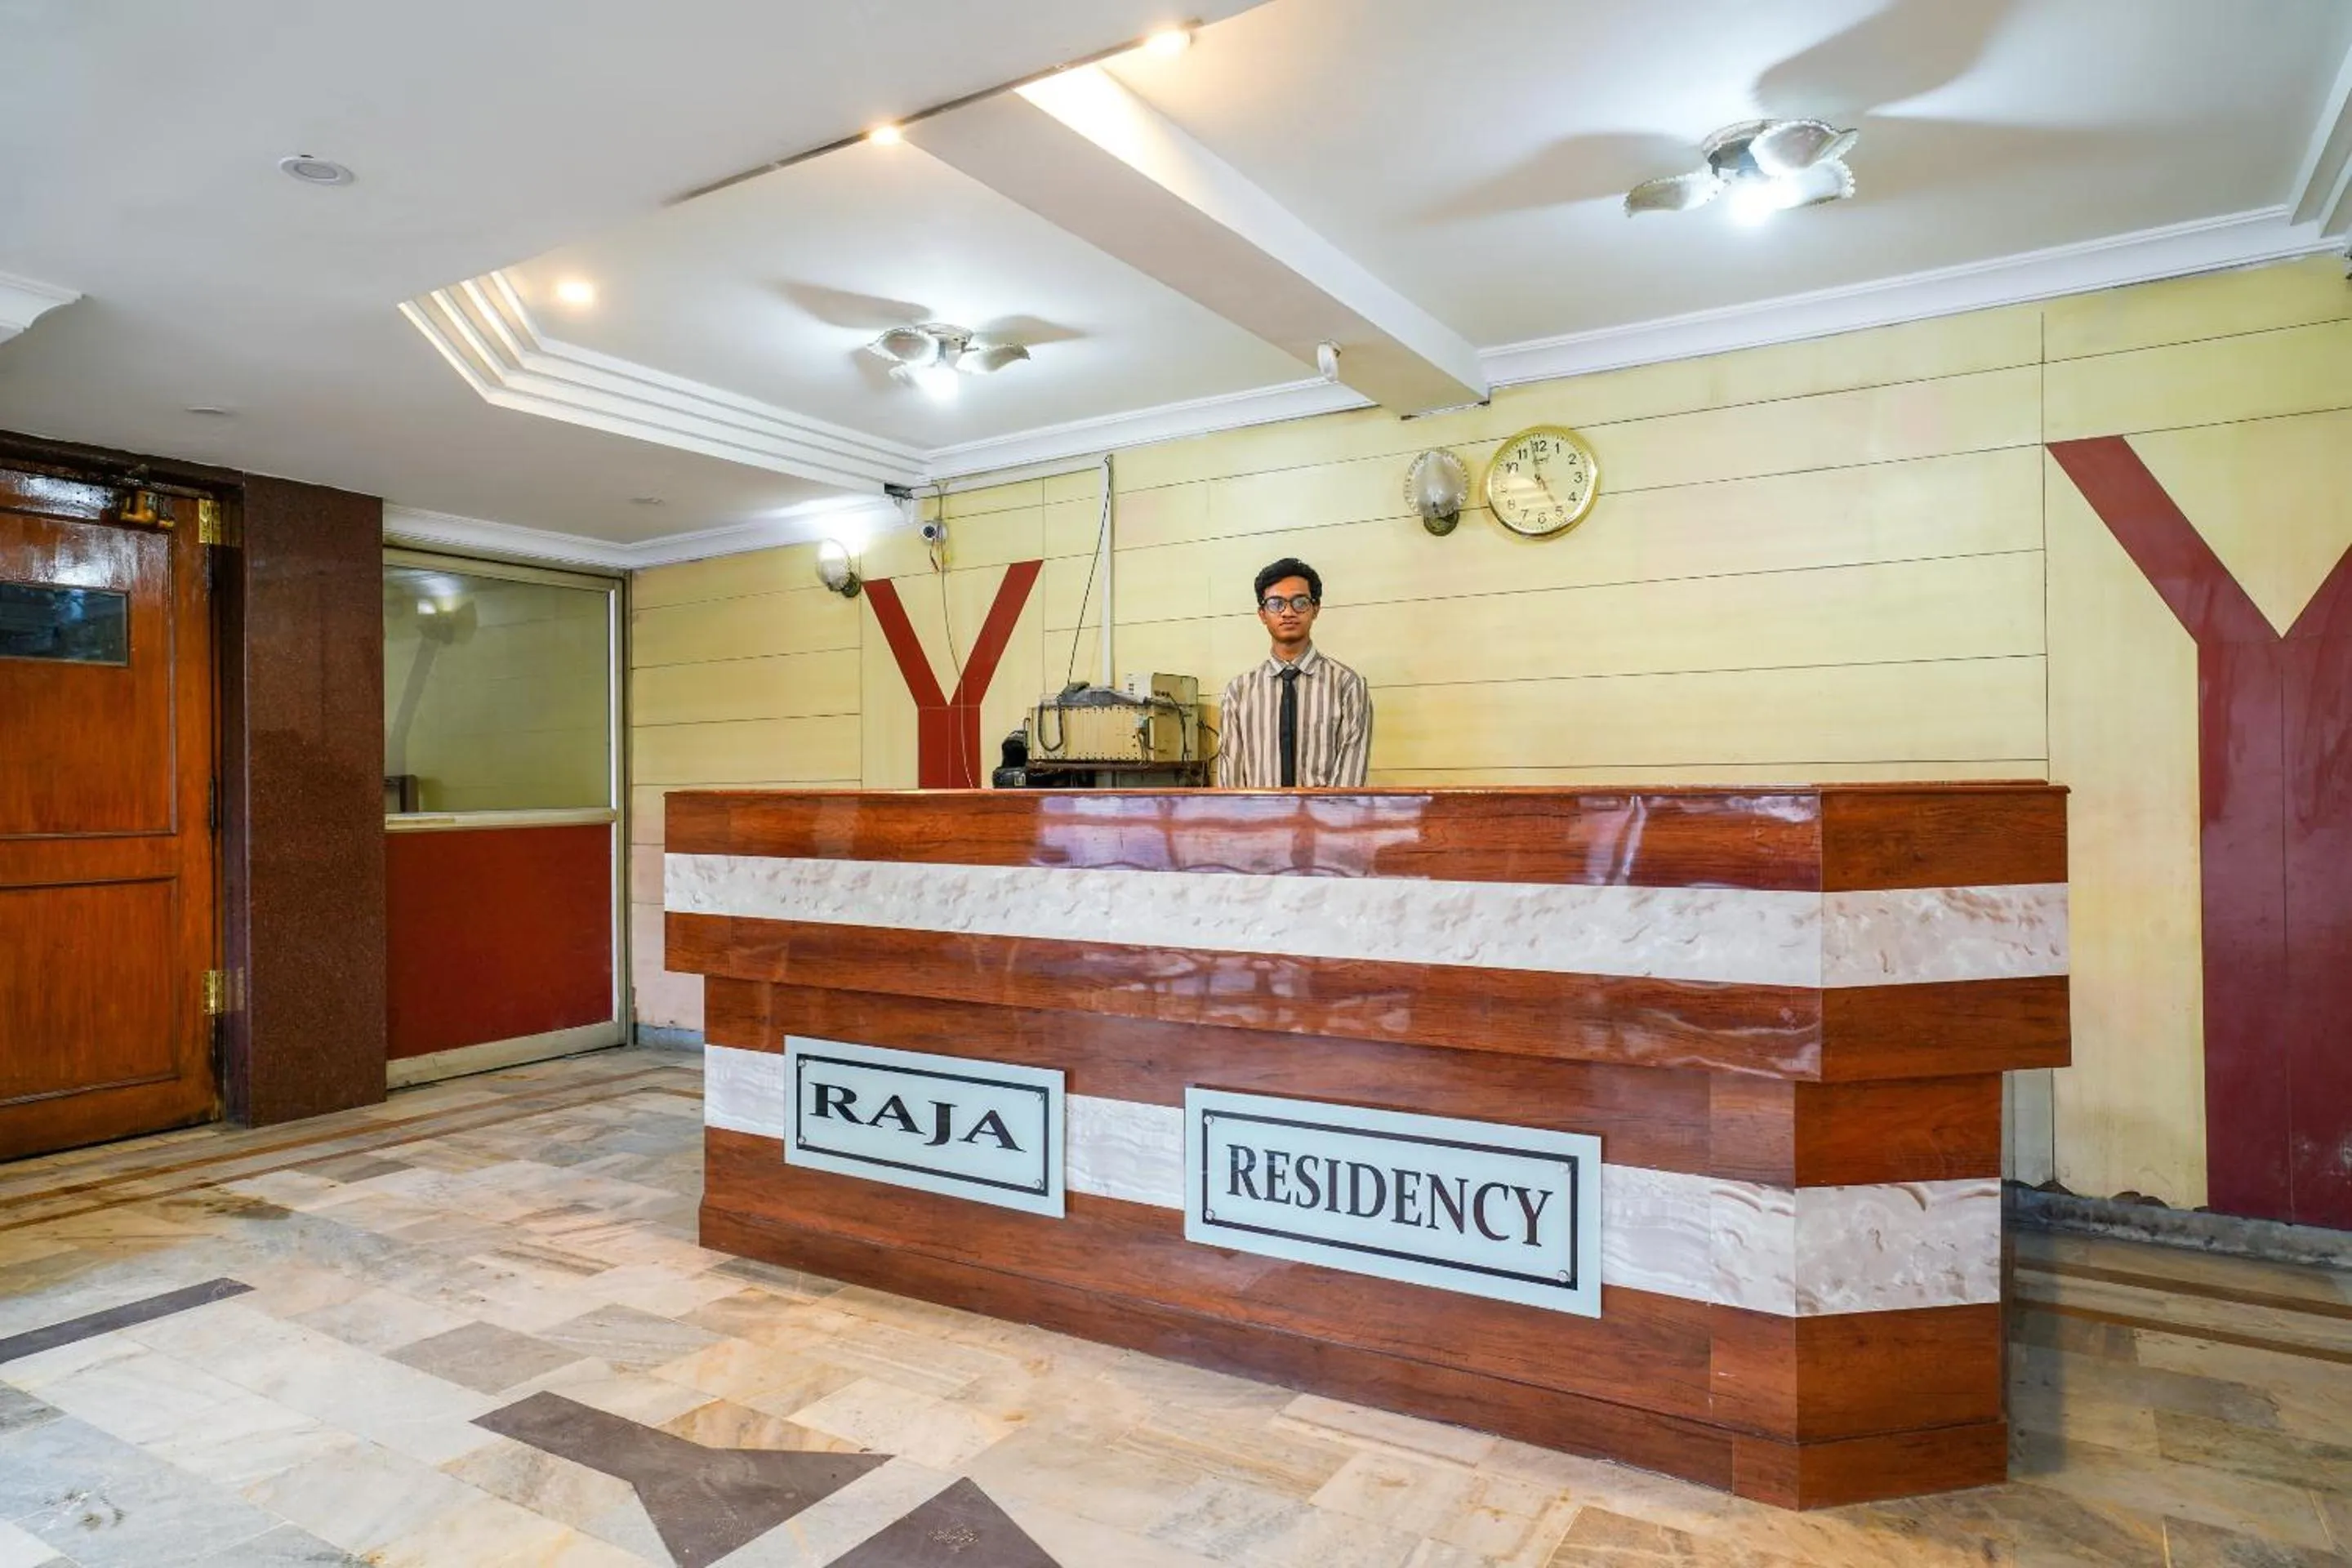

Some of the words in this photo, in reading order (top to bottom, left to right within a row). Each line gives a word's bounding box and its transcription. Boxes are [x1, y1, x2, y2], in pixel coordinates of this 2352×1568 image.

[1535, 439, 1547, 452] 12
[1517, 448, 1528, 460] 11
[1567, 453, 1577, 465] 2
[1574, 471, 1583, 483] 3
[1567, 492, 1577, 502] 4
[1521, 509, 1530, 521] 7
[1537, 512, 1548, 523] 6
[1555, 506, 1564, 518] 5
[808, 1082, 1027, 1153] RAJA
[1226, 1143, 1554, 1248] RESIDENCY
